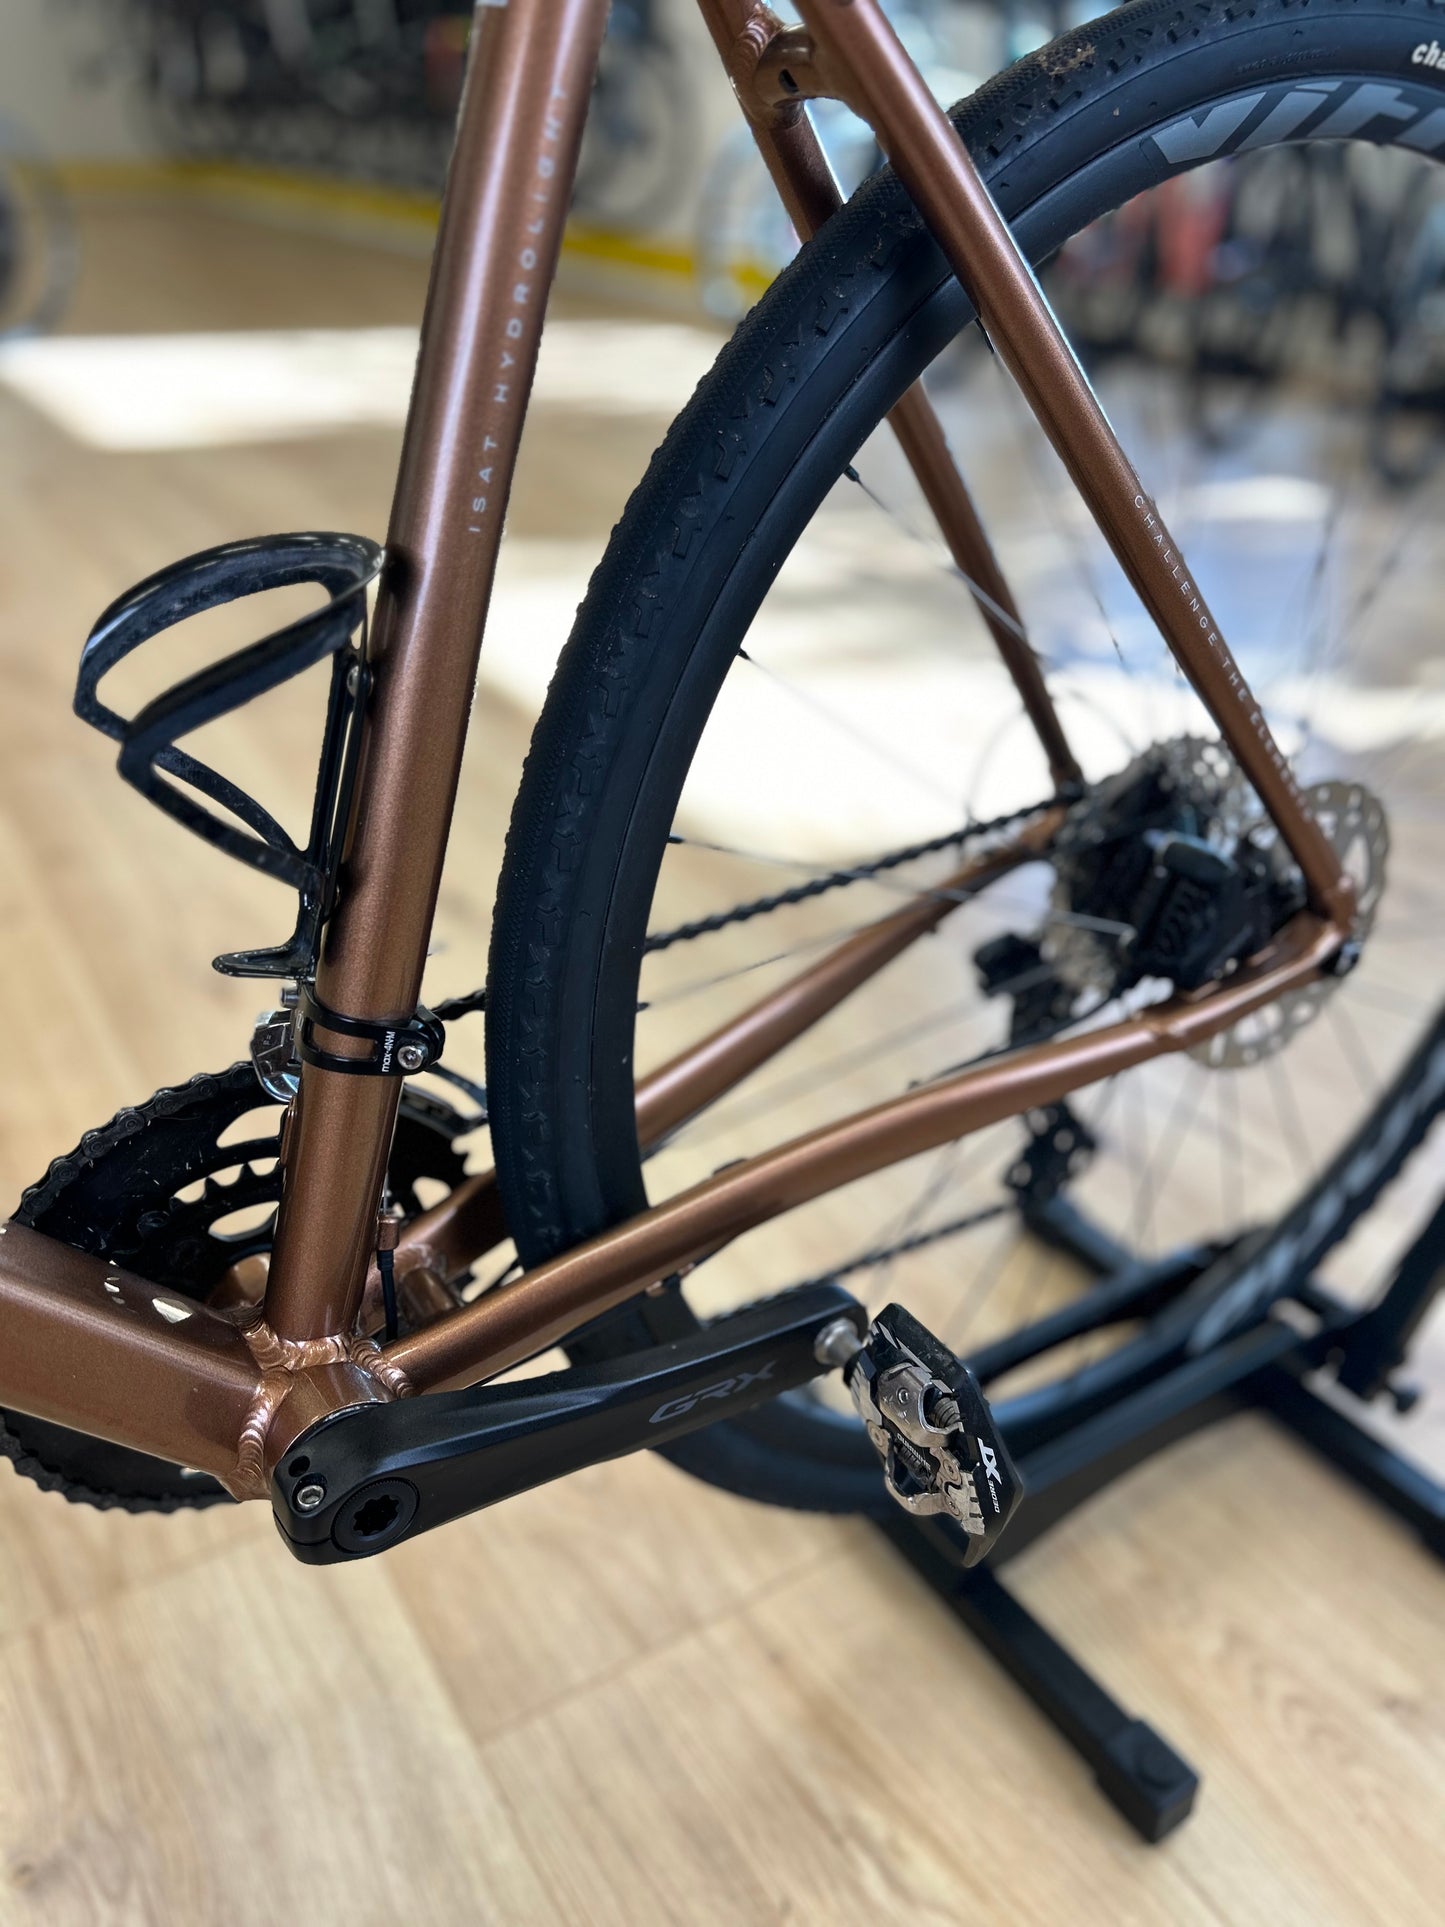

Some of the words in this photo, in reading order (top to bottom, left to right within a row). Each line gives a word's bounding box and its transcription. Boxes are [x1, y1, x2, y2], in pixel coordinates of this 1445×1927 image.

[468, 435, 498, 532] ISAT
[1134, 495, 1218, 647] CHALLENGE
[1221, 656, 1249, 702] THE
[649, 1360, 776, 1423] GRX
[977, 1437, 1002, 1485] XT
